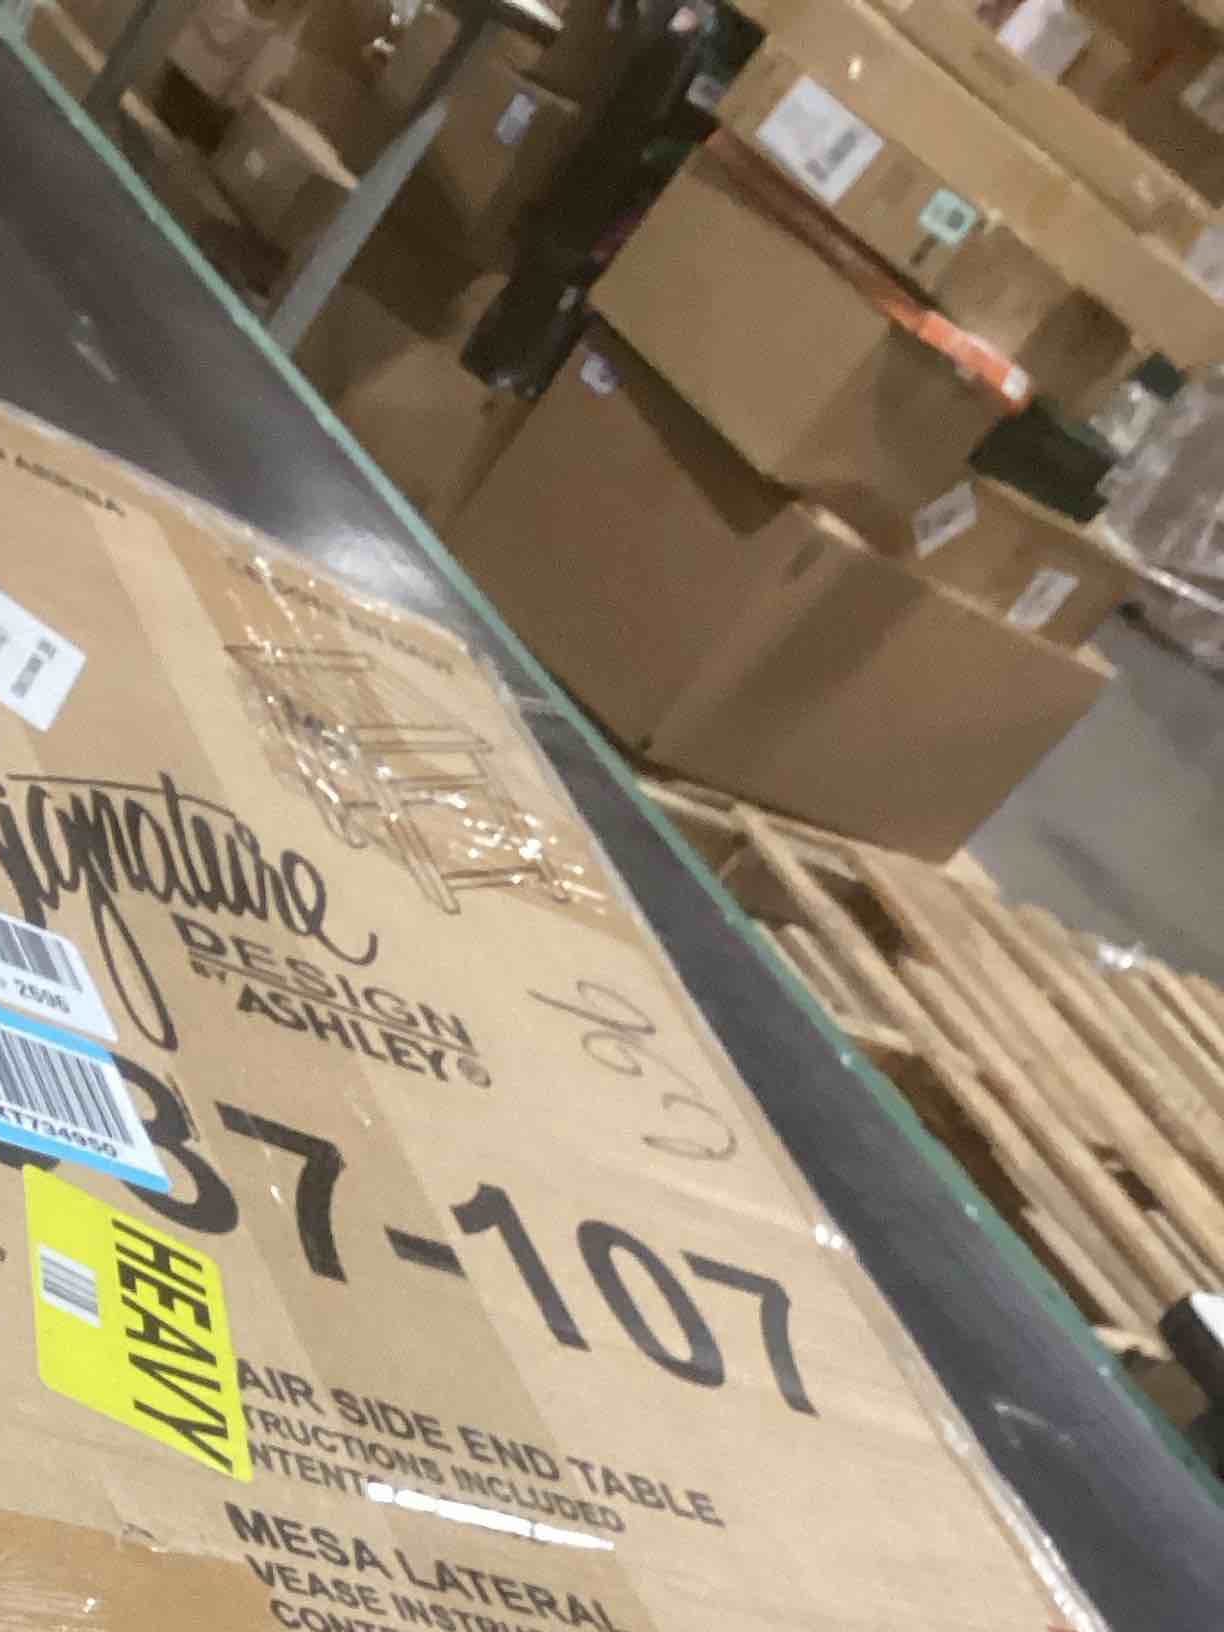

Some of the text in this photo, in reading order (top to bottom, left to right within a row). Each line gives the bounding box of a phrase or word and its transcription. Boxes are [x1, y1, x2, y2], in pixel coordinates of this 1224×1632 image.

[171, 912, 475, 1048] DESIGN
[112, 1217, 234, 1473] HEAVY
[236, 1357, 725, 1528] AIR SIDE END TABLE
[240, 1403, 627, 1533] TRUCTIONS INCLUDED
[224, 1502, 394, 1581] MESA
[245, 1554, 387, 1617] VEASE
